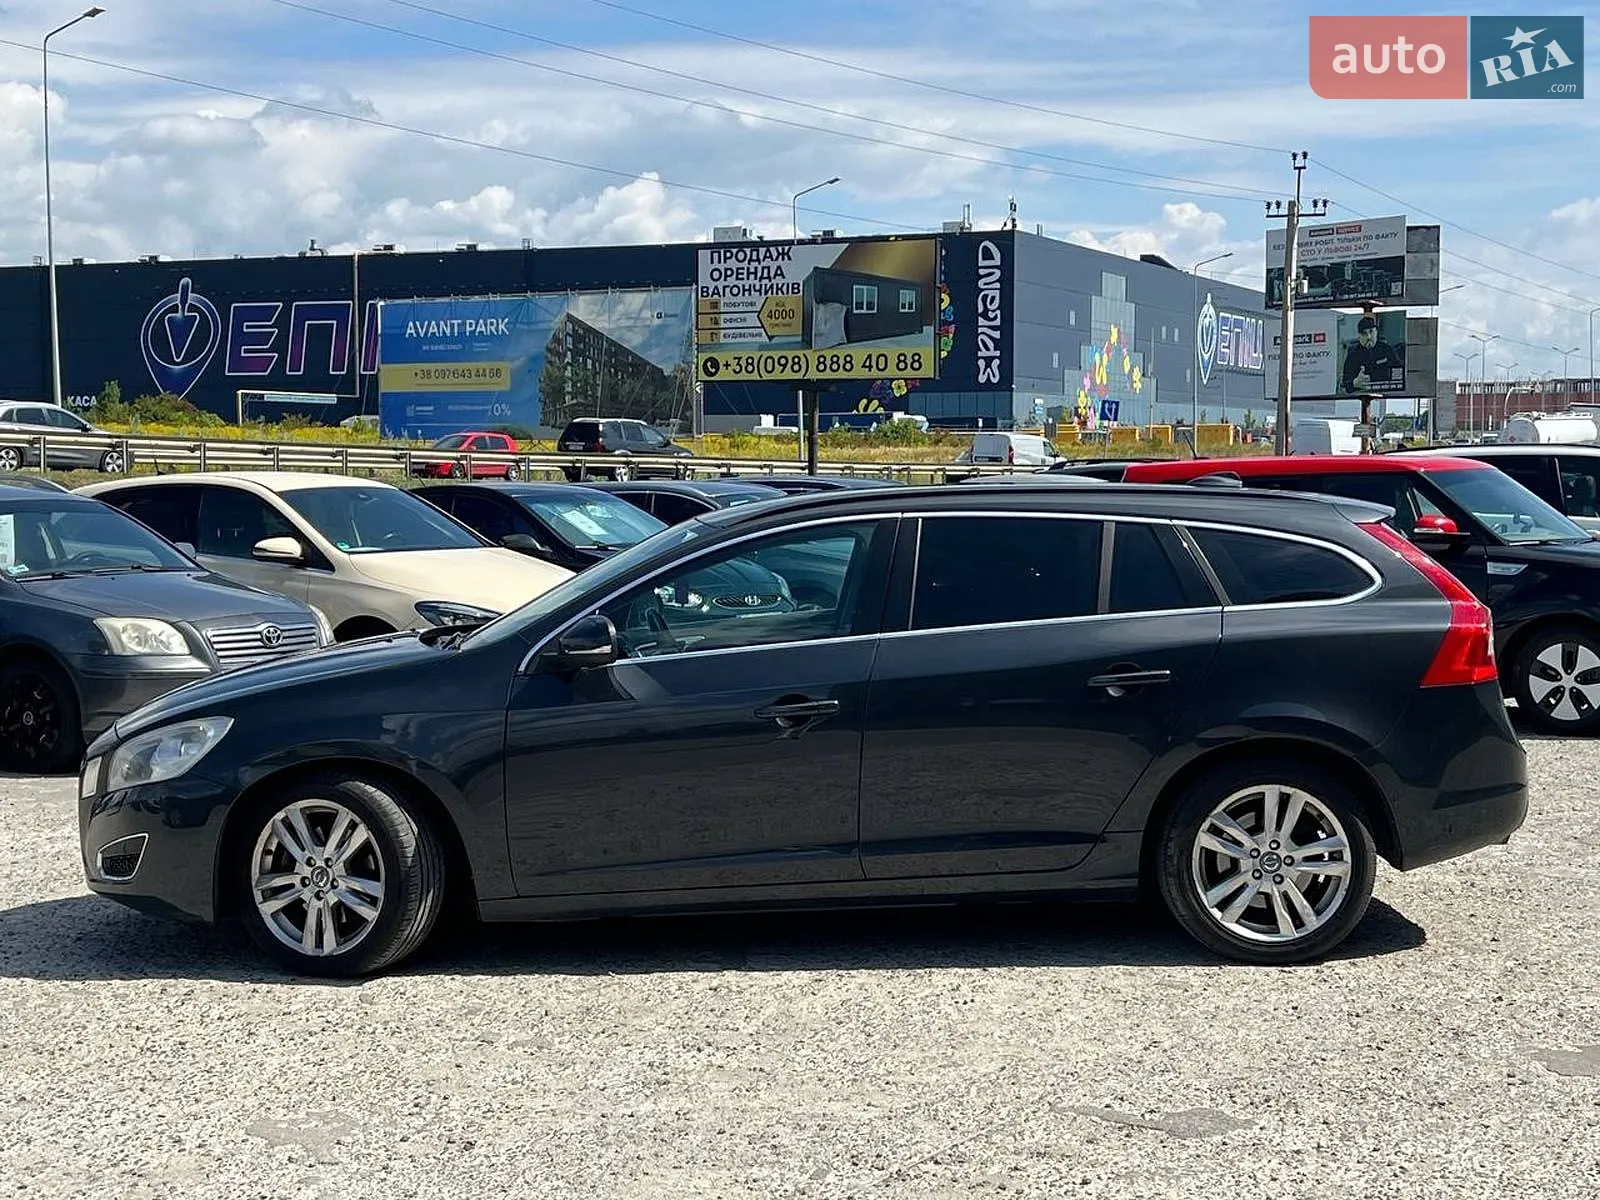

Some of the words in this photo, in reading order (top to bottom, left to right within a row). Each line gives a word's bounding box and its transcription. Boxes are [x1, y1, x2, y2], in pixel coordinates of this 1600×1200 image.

[710, 246, 792, 265] ПРОДАЖ
[710, 266, 785, 282] ОРЕНДА
[700, 283, 801, 298] ВАГОНЧИКІВ
[766, 309, 795, 320] 4000
[405, 320, 462, 338] AVANT
[465, 318, 510, 336] PARK
[722, 354, 810, 378] +38(098)
[815, 354, 854, 373] 888
[861, 353, 888, 372] 40
[896, 352, 923, 372] 88
[67, 395, 97, 407] КАСА
